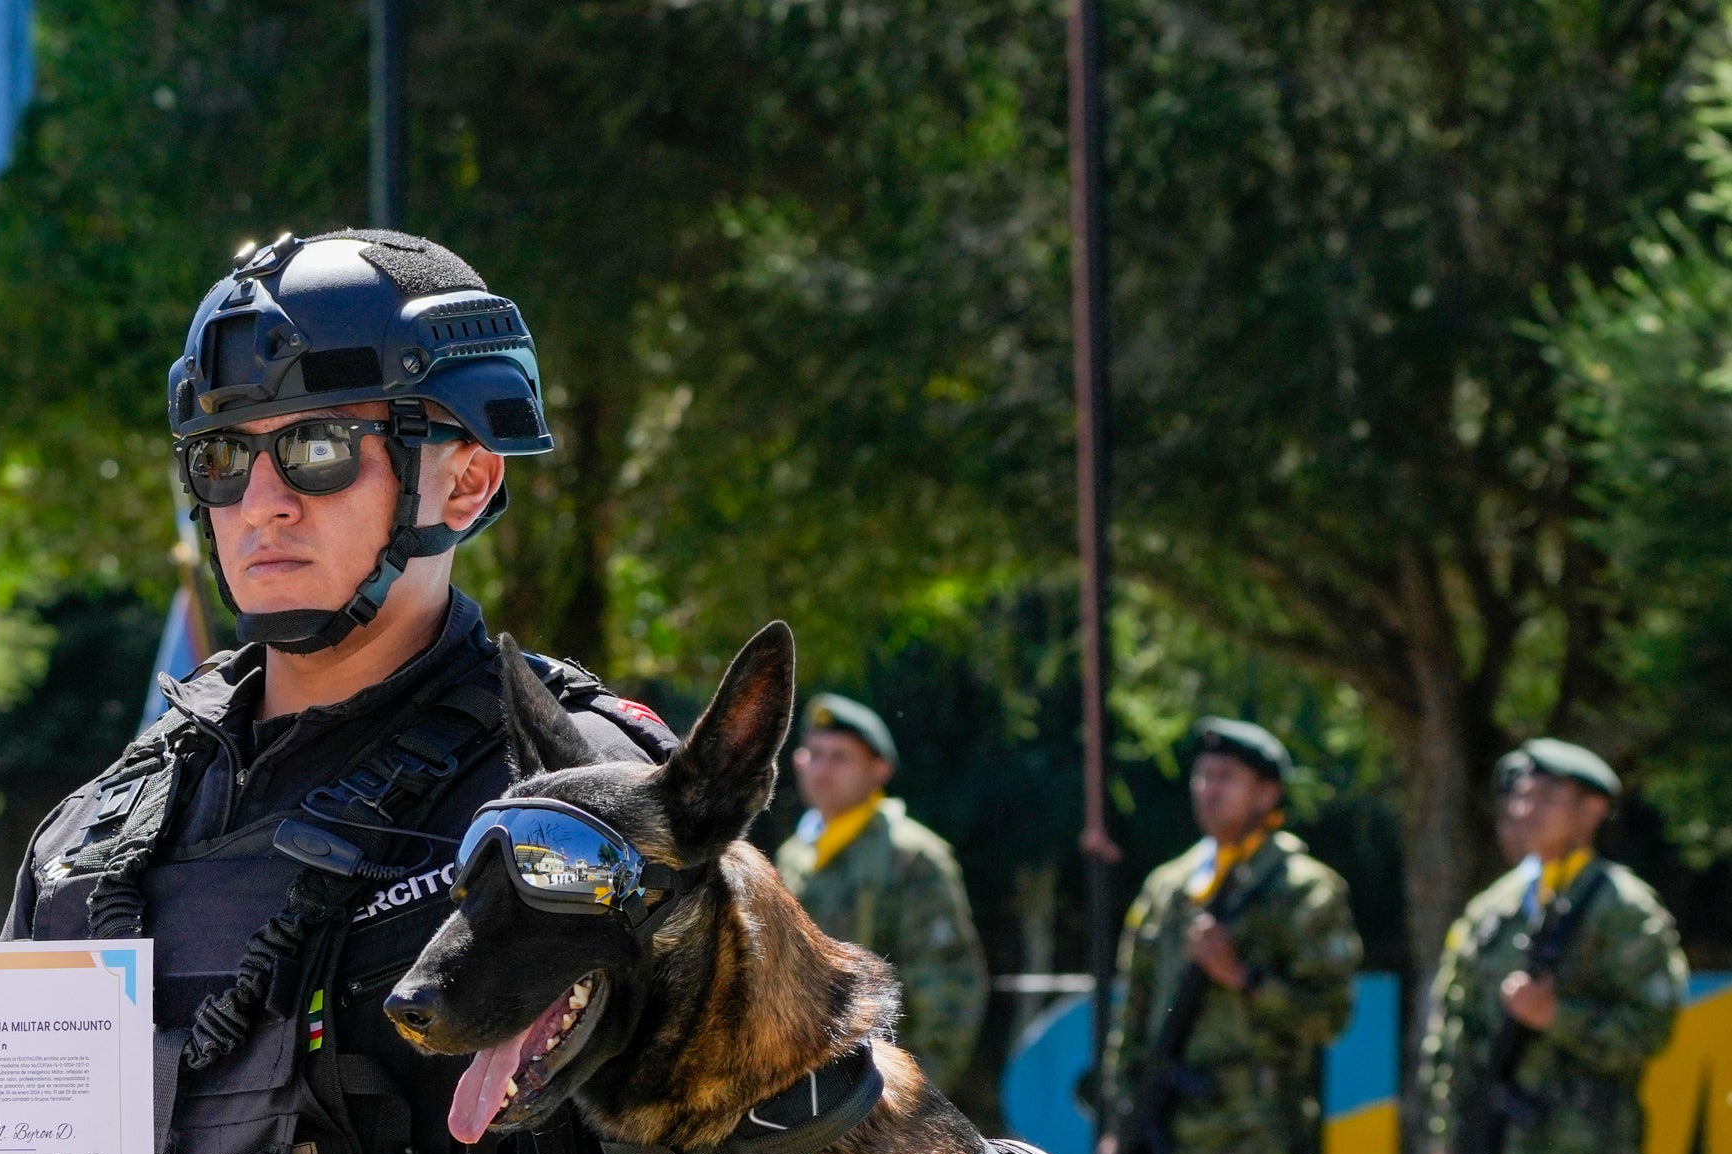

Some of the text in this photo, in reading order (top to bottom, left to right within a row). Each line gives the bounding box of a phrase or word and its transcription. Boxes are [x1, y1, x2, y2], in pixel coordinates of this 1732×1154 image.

[11, 1021, 51, 1032] MILITAR
[53, 1020, 112, 1031] CONJUNTO
[13, 1123, 53, 1143] Byron
[55, 1123, 76, 1140] D.
